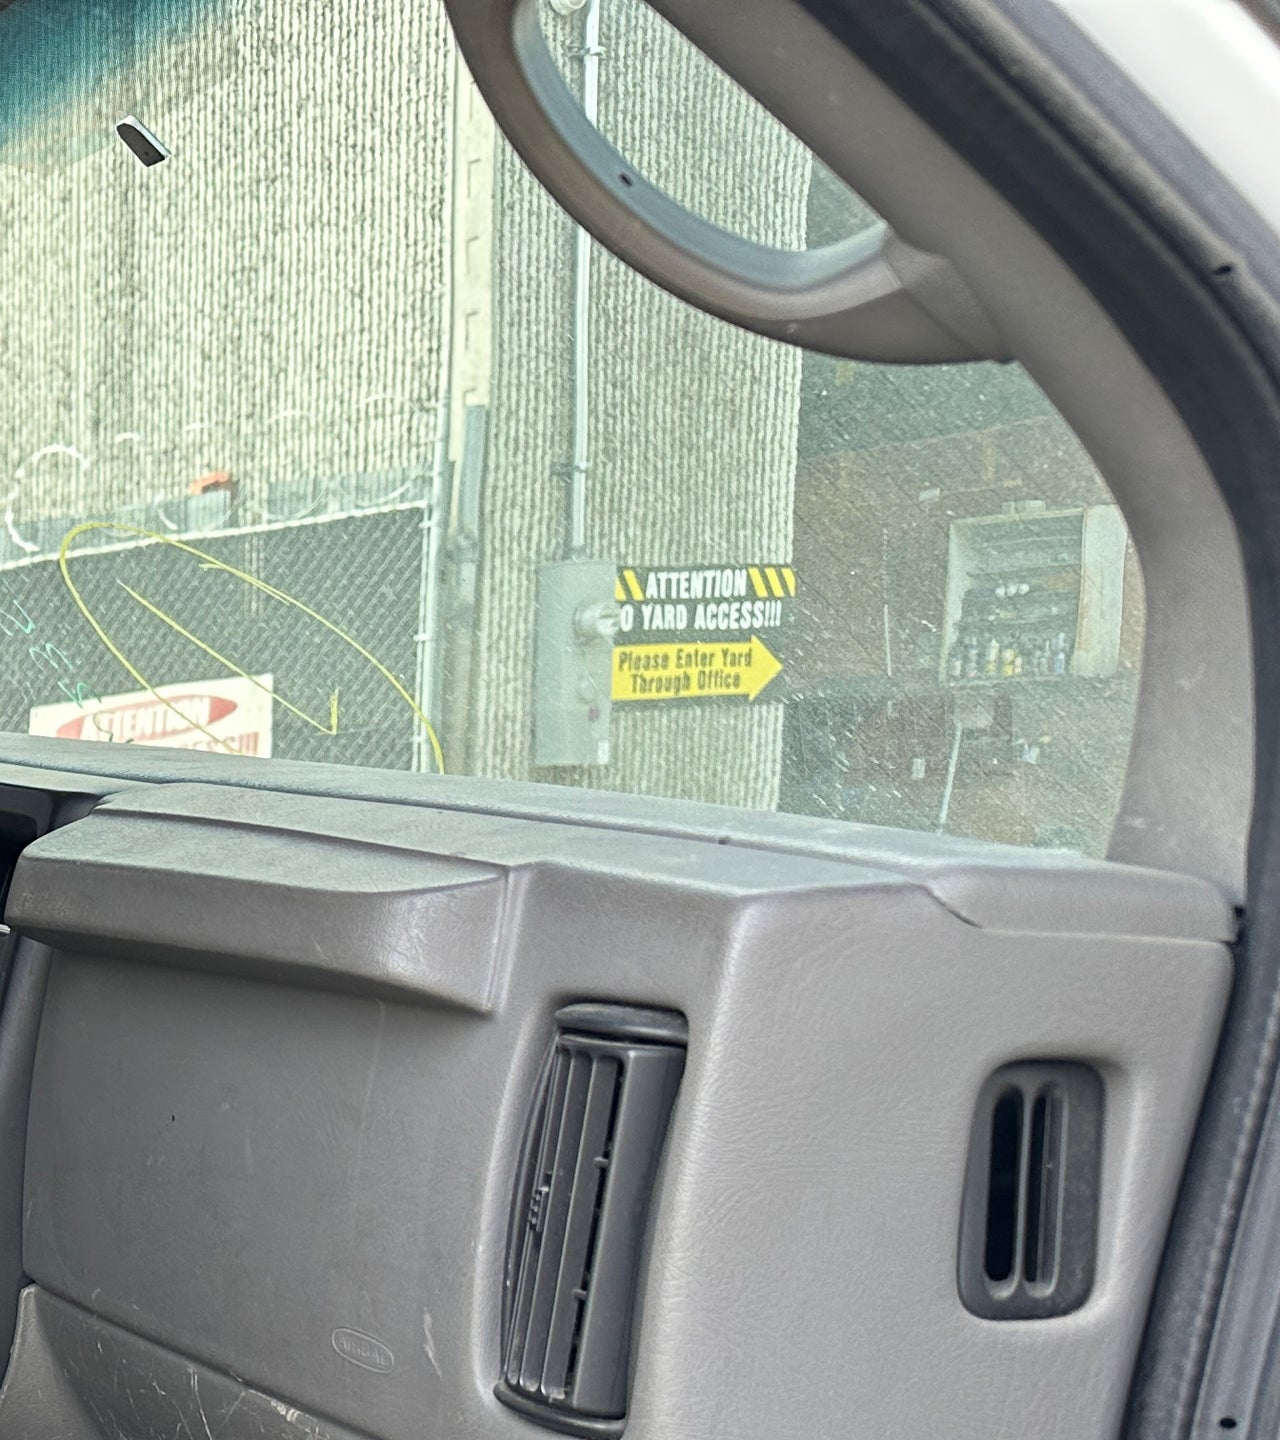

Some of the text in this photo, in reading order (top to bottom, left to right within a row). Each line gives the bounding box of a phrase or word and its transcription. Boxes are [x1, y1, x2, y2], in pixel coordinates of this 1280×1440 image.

[645, 568, 747, 600] ATTENTION
[620, 600, 782, 632] O YARD ACCESS!!!
[618, 647, 753, 673] Please Enter Yard
[631, 670, 741, 696] Through Office
